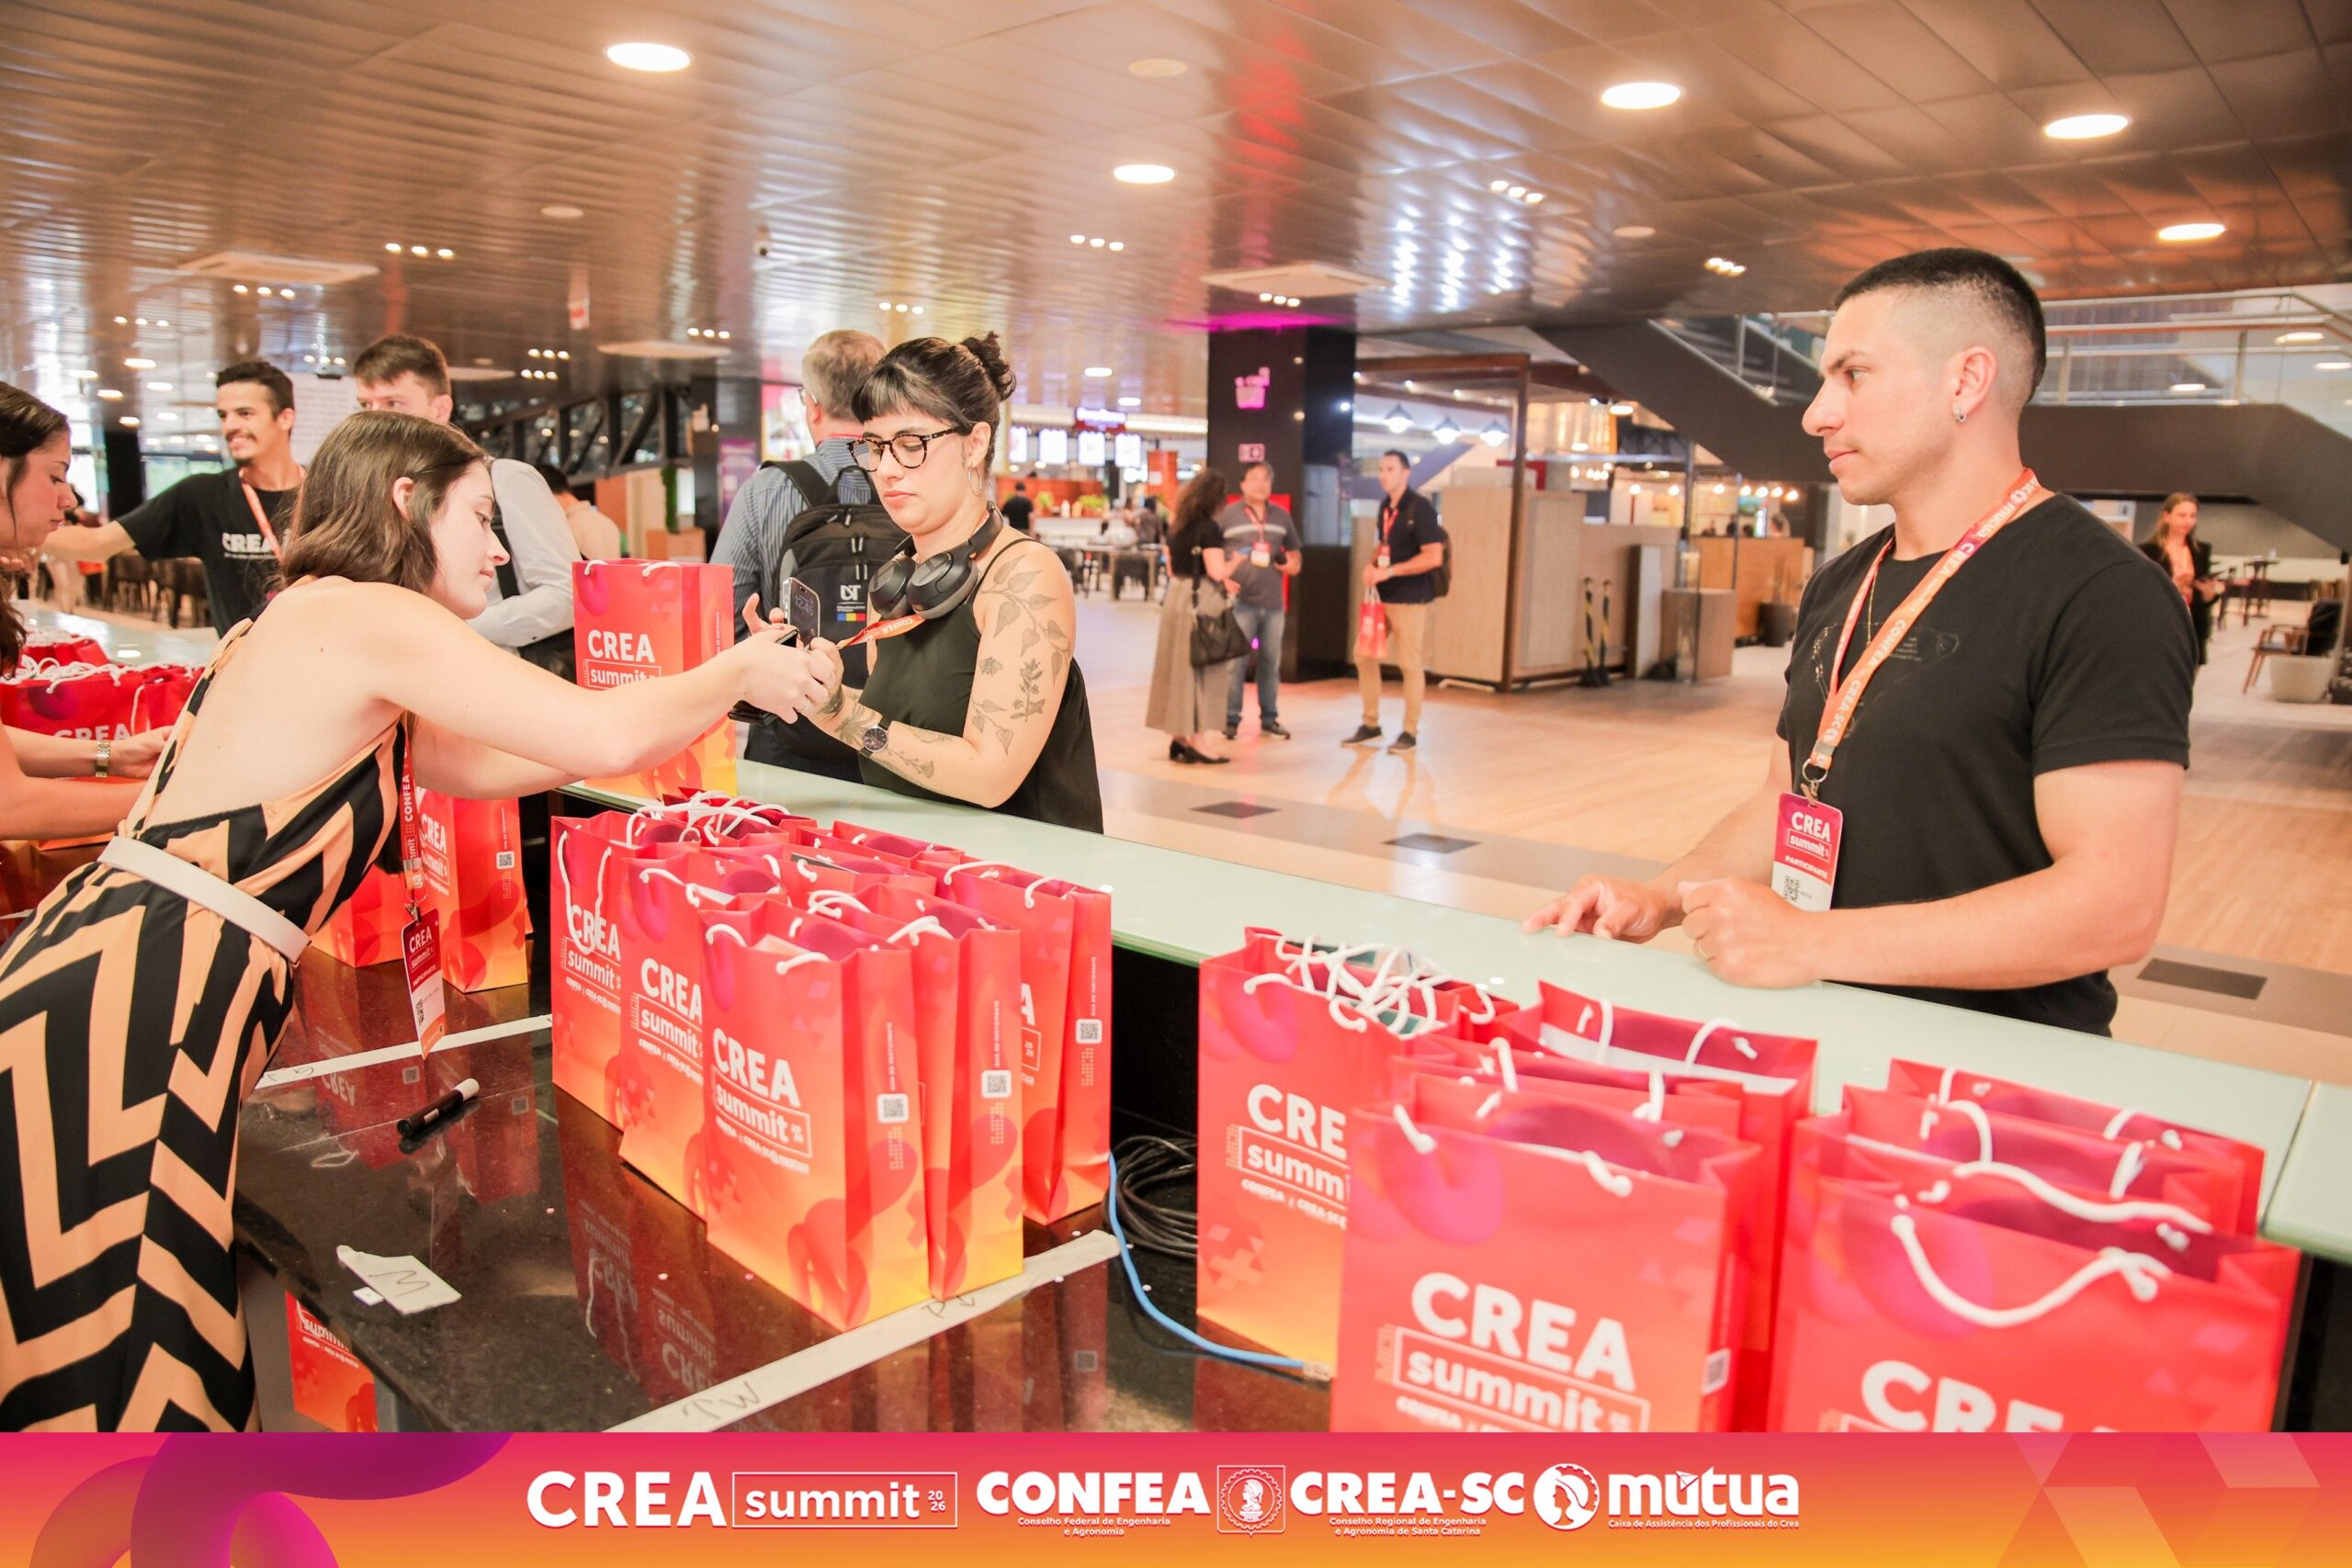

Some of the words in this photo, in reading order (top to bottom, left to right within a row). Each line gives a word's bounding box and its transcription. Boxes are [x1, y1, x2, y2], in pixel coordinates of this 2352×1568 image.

[1939, 542, 1975, 576] CREA
[588, 629, 656, 663] CREA
[1868, 619, 1907, 666] CONFEA
[591, 669, 648, 685] summit
[401, 773, 413, 822] CONFEA
[1790, 835, 1825, 857] summit
[1792, 811, 1831, 843] CREA
[409, 926, 433, 953] CREA
[569, 904, 621, 962] CREA
[568, 951, 615, 990] summit
[640, 957, 702, 1026] CREA
[641, 1009, 697, 1060] summit
[712, 1027, 802, 1108] CREA
[717, 1084, 789, 1143] summit
[1247, 1084, 1348, 1161] CRE
[1411, 1271, 1636, 1392] CREA
[1408, 1351, 1604, 1432] summit
[1861, 1360, 2119, 1432] CRE
